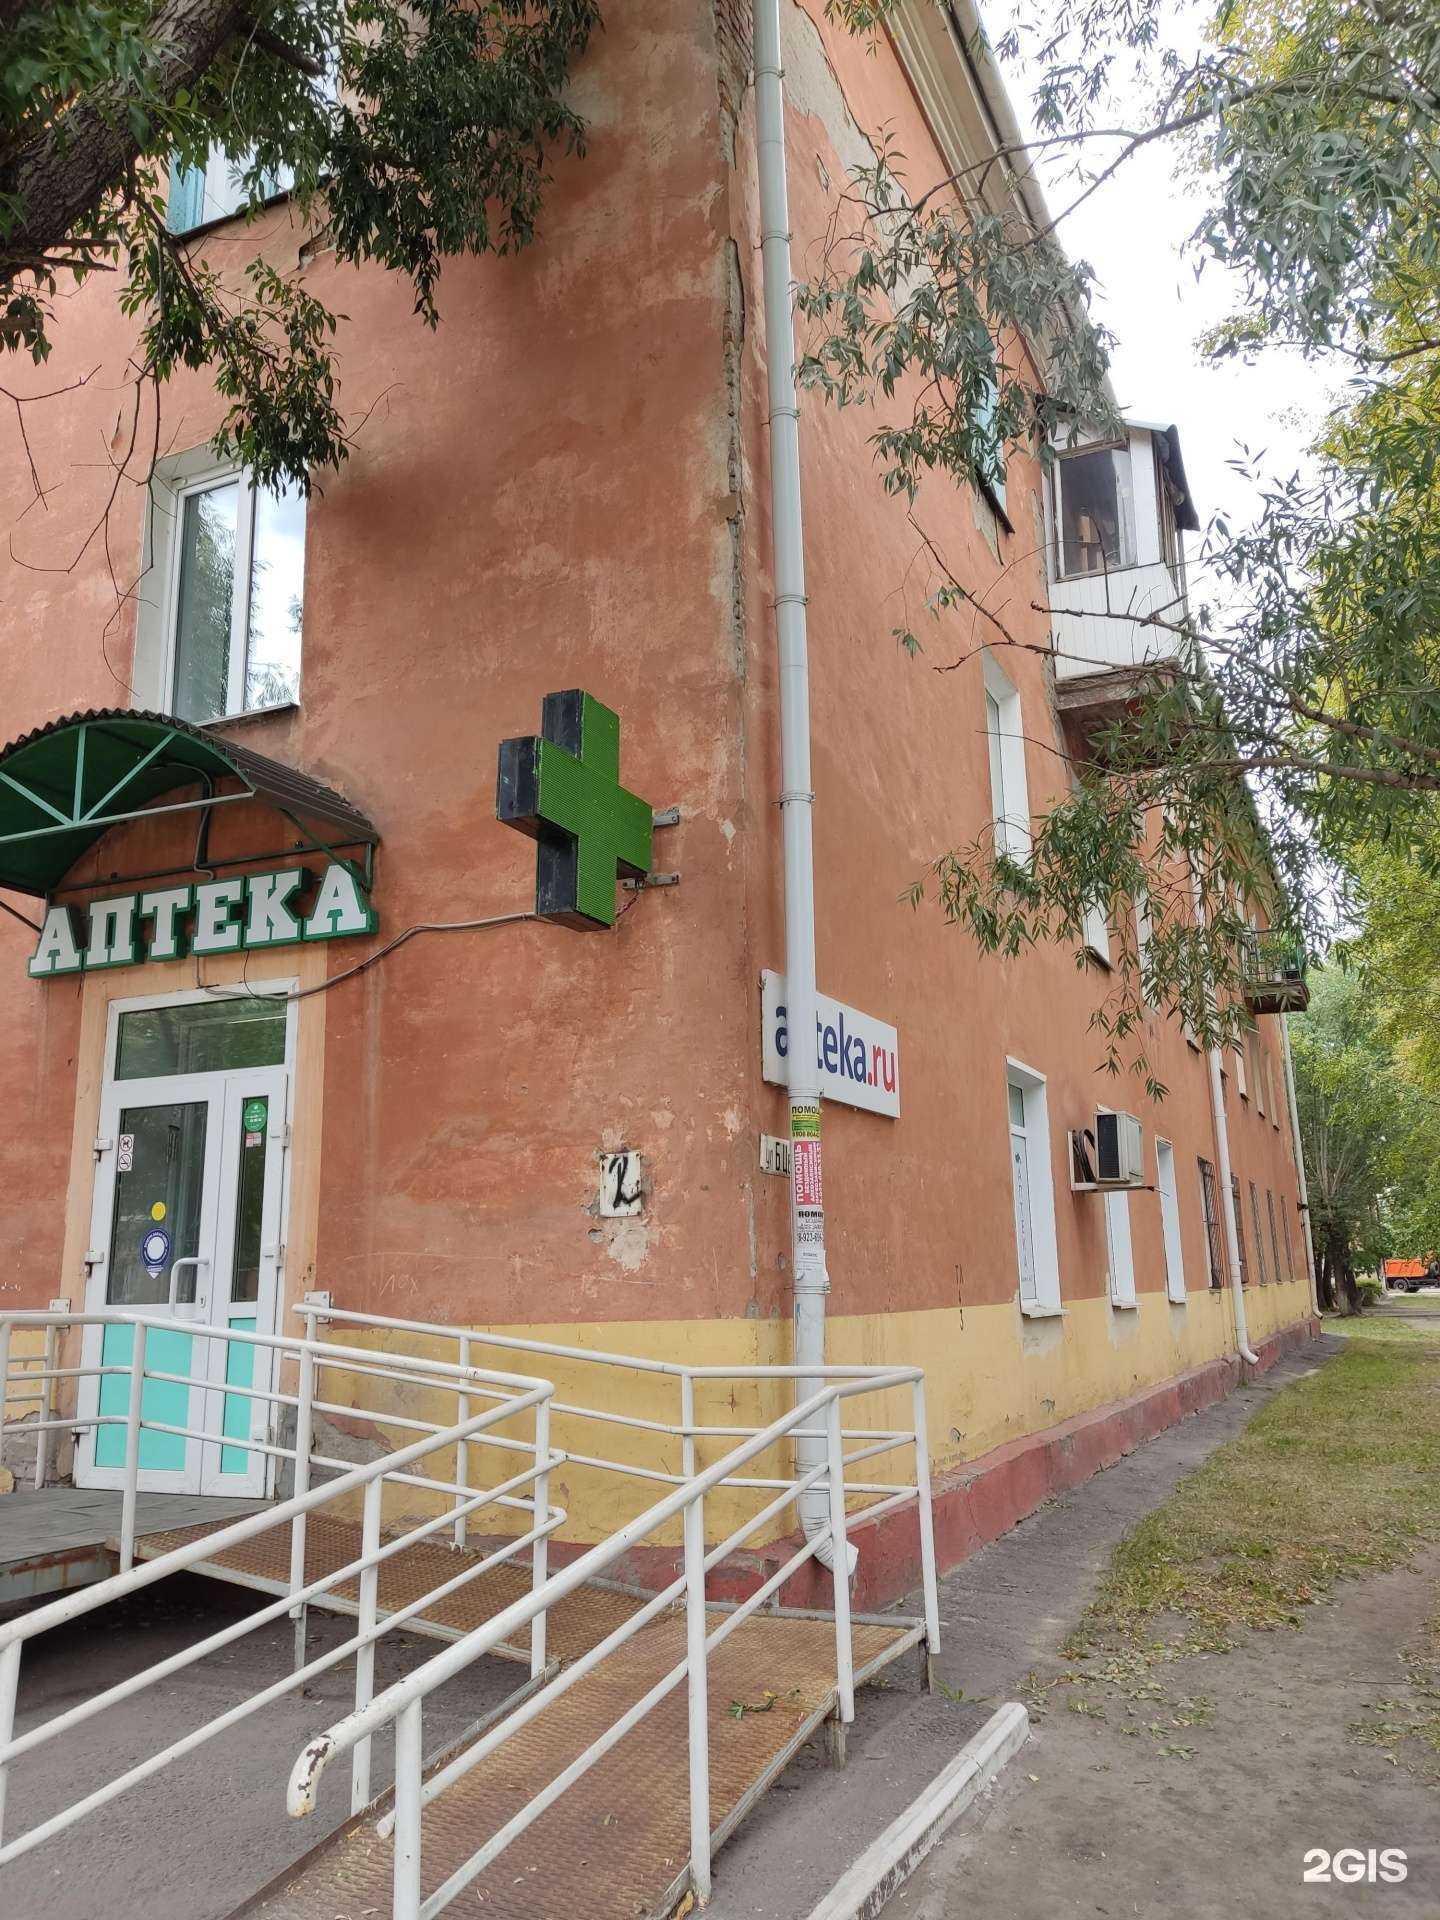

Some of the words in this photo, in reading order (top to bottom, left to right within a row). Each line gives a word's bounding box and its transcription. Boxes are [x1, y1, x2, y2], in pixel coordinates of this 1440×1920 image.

[28, 860, 372, 977] АПТЕКА
[775, 1005, 897, 1093] ateka.ru
[795, 1144, 804, 1202] ПОМОЩЬ
